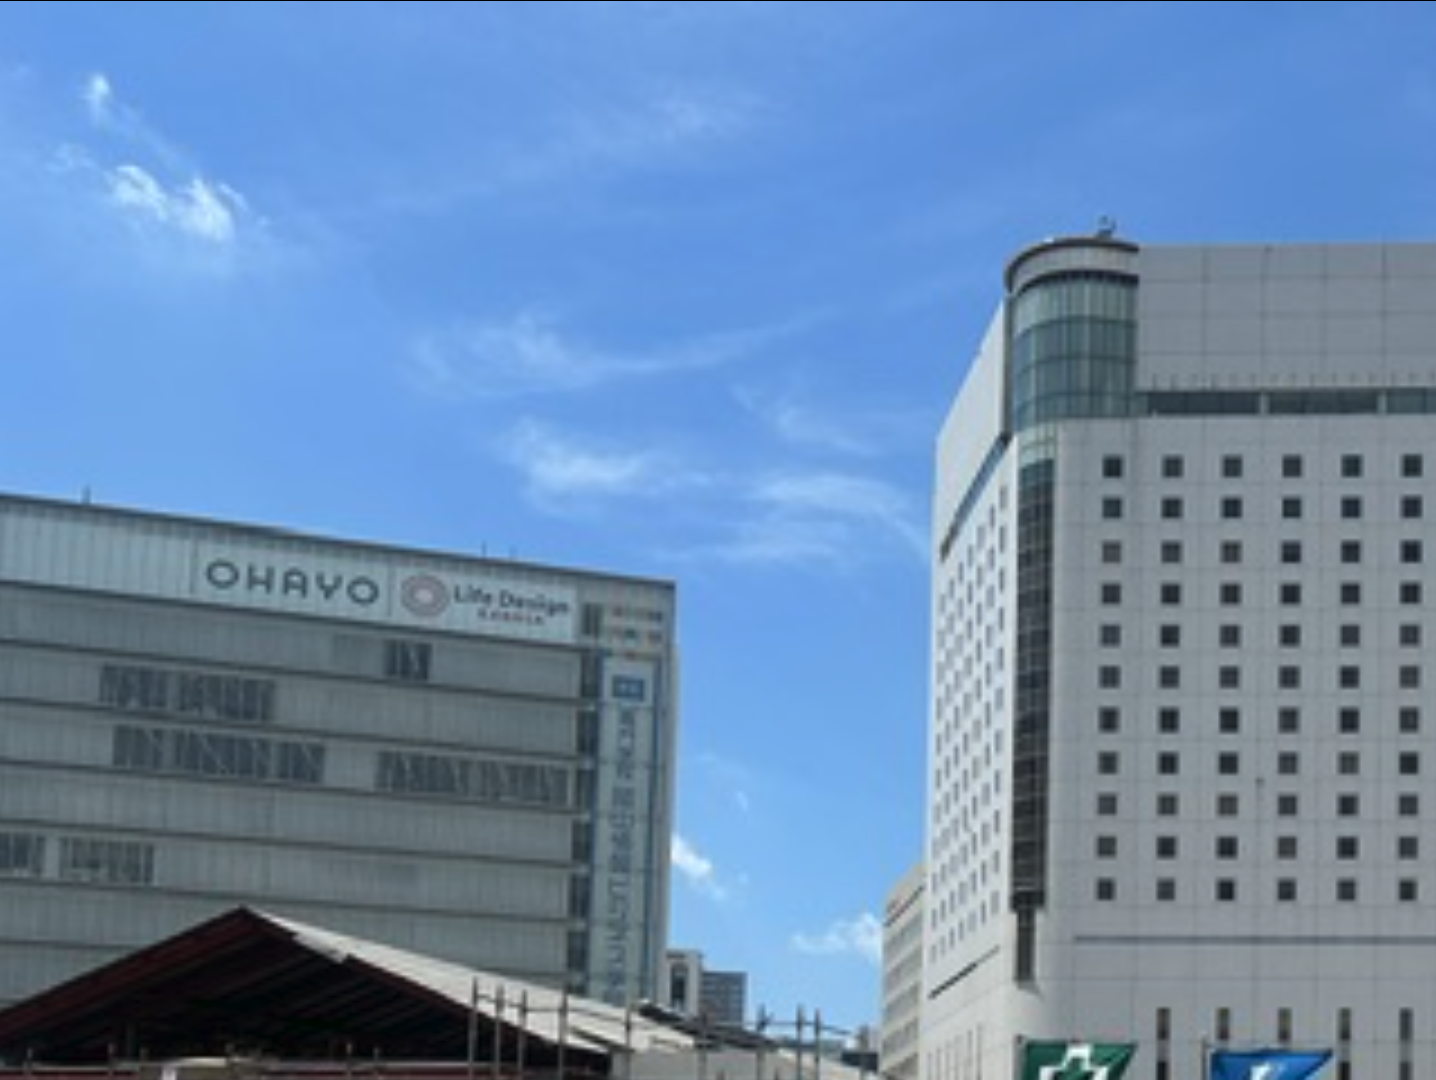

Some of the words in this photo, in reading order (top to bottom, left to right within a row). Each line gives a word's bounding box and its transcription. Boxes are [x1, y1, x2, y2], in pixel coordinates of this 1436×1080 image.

[205, 560, 380, 605] OHAYO
[453, 584, 493, 607] Life
[498, 588, 569, 618] Design
